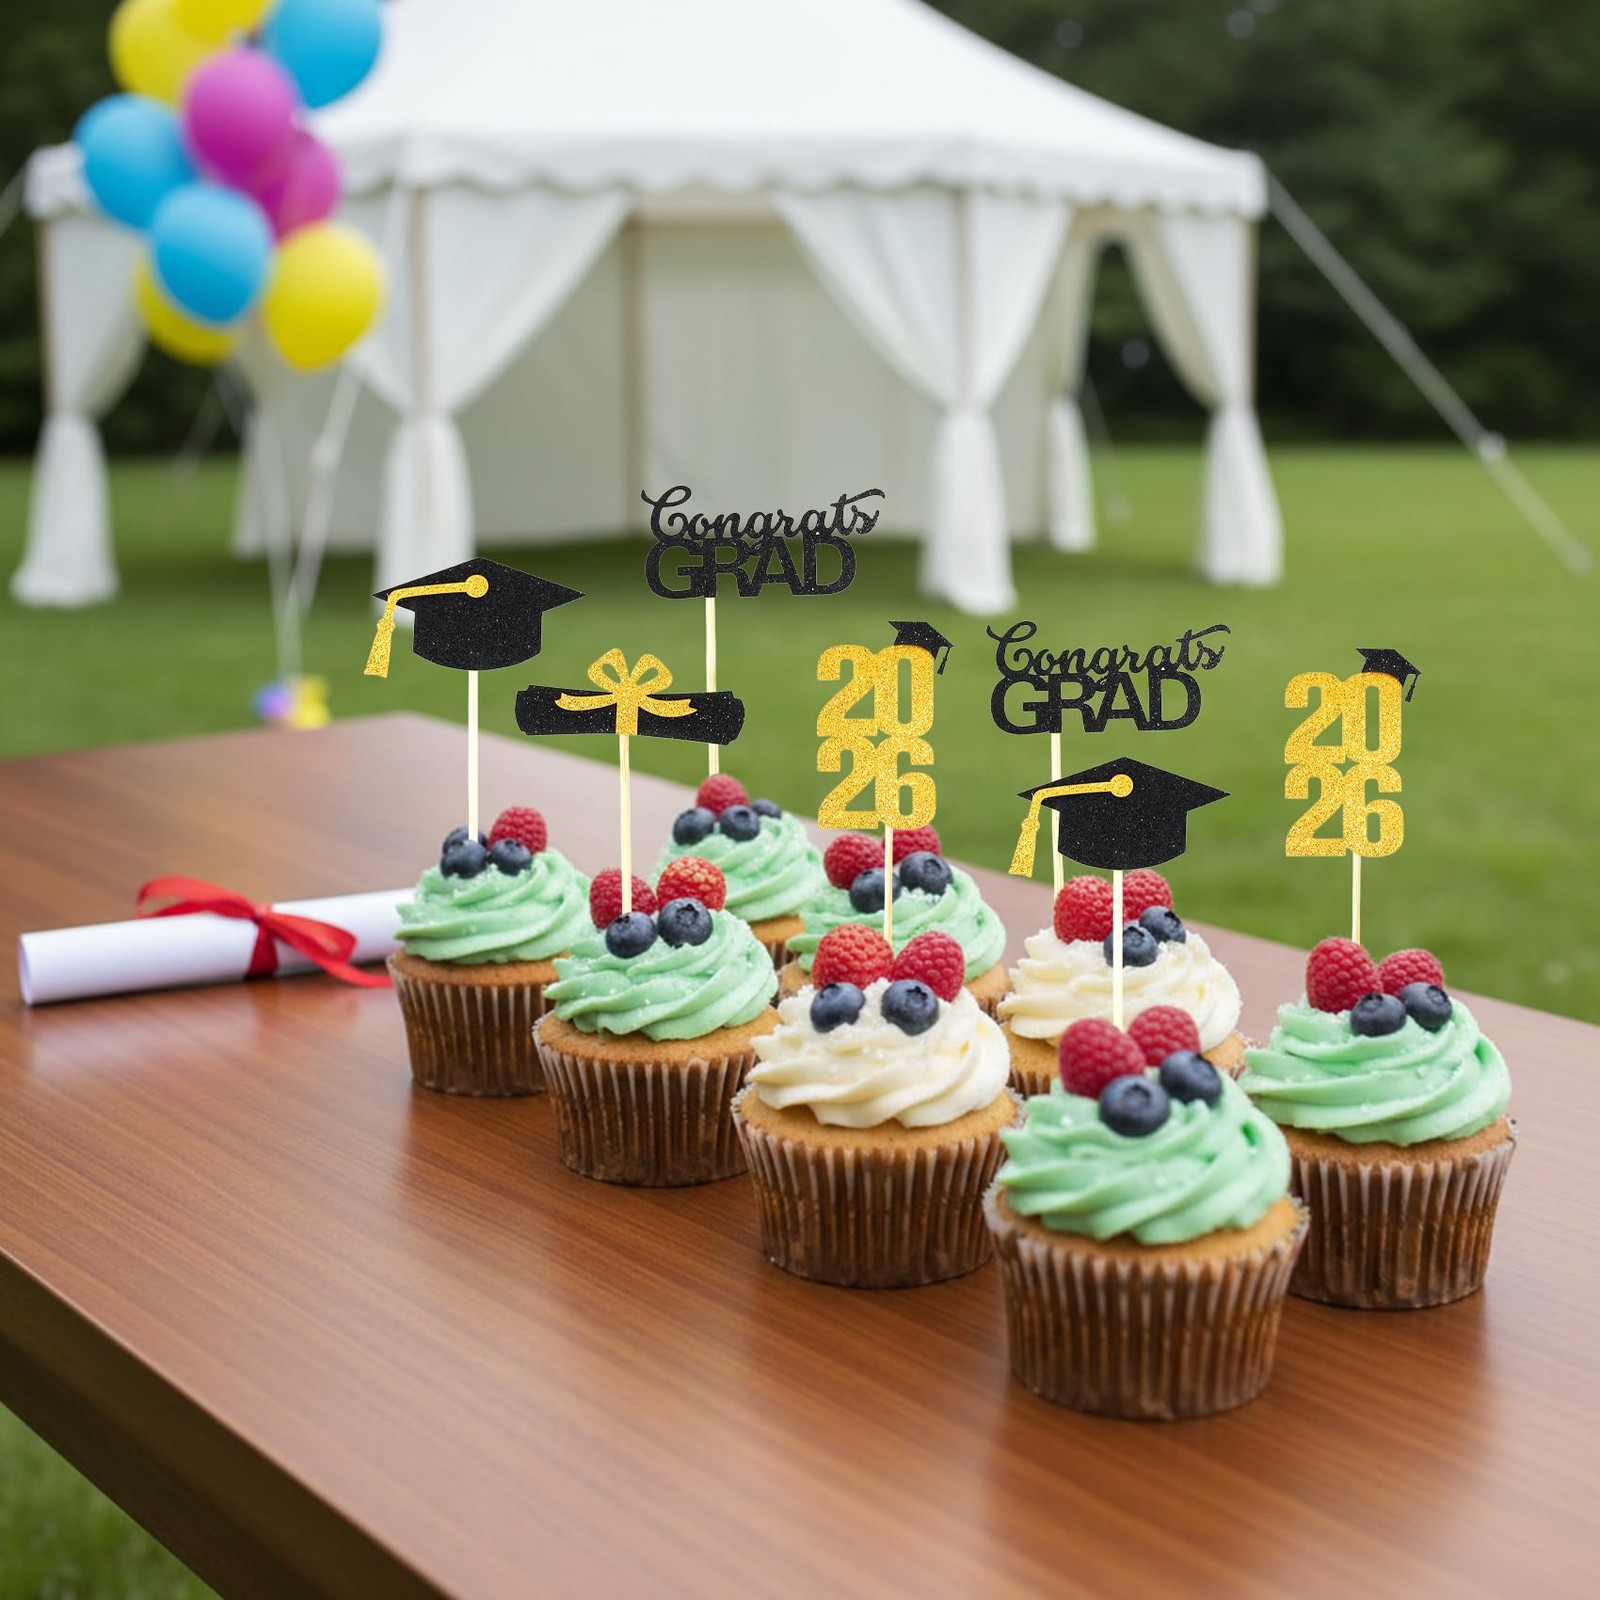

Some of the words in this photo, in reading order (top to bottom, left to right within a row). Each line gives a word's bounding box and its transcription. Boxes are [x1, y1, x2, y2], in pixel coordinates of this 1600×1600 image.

[641, 485, 886, 556] Congrats
[645, 536, 856, 599] GRAD
[816, 644, 935, 737] 20
[986, 621, 1231, 691] Congrats
[990, 672, 1202, 734] GRAD
[1284, 671, 1402, 764] 20
[816, 735, 937, 830] 26
[1284, 761, 1405, 858] 26
